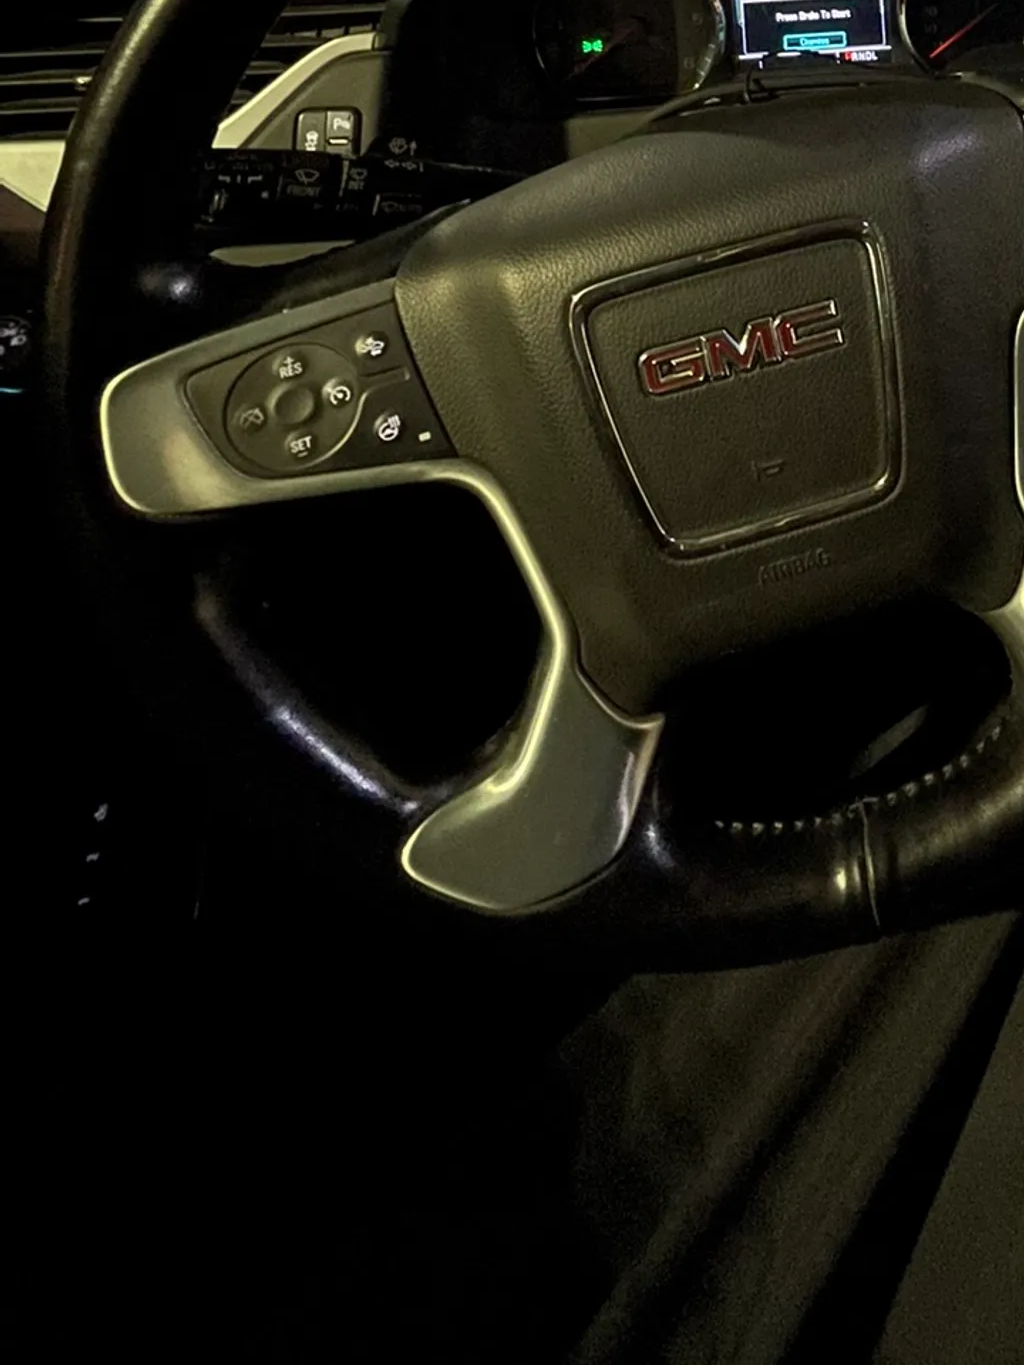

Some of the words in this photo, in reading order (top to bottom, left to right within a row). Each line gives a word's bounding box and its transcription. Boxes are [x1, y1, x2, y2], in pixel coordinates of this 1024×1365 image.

[637, 298, 848, 397] GMC
[279, 361, 302, 379] RES
[290, 435, 312, 454] SET
